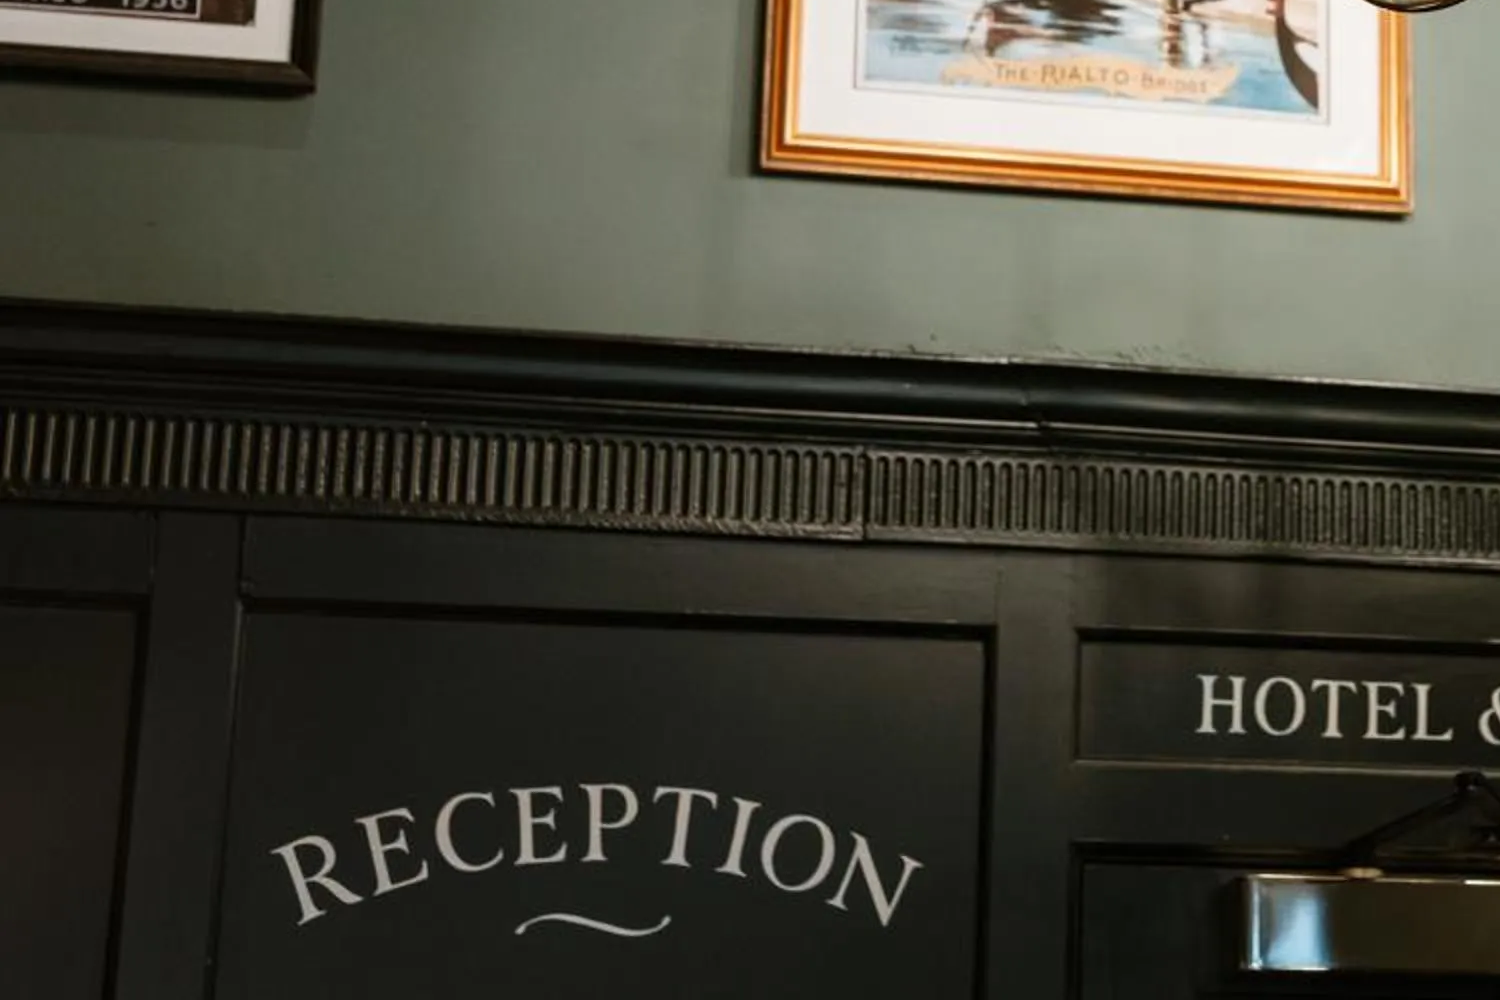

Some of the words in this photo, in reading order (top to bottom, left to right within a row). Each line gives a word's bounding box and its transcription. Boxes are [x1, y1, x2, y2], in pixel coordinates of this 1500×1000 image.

[1040, 64, 1130, 86] RIALTO
[1195, 674, 1454, 741] HOTEL
[270, 783, 924, 928] RECEPTION
